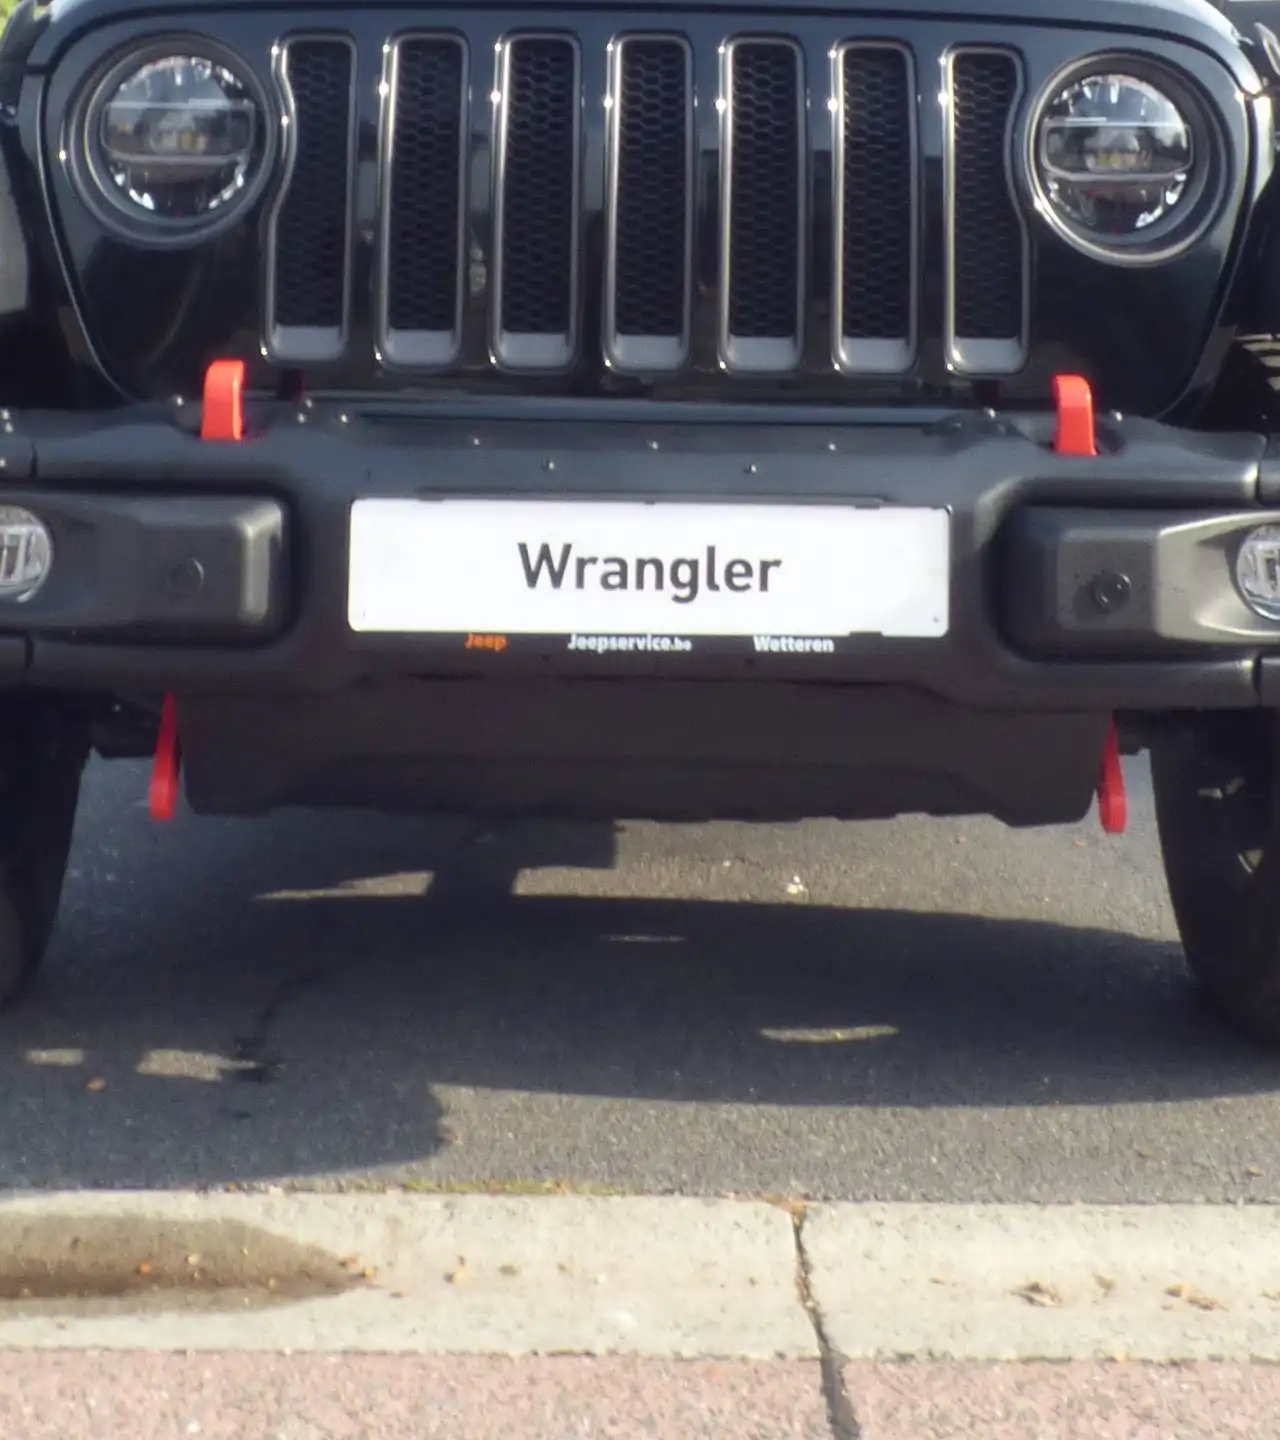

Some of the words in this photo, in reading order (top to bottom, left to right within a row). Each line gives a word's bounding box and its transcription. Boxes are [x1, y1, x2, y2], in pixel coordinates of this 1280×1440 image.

[517, 542, 782, 603] Wrangler
[464, 632, 508, 652] Jeep
[567, 633, 692, 653] Jeepservice.be
[753, 634, 834, 653] Wetteren
